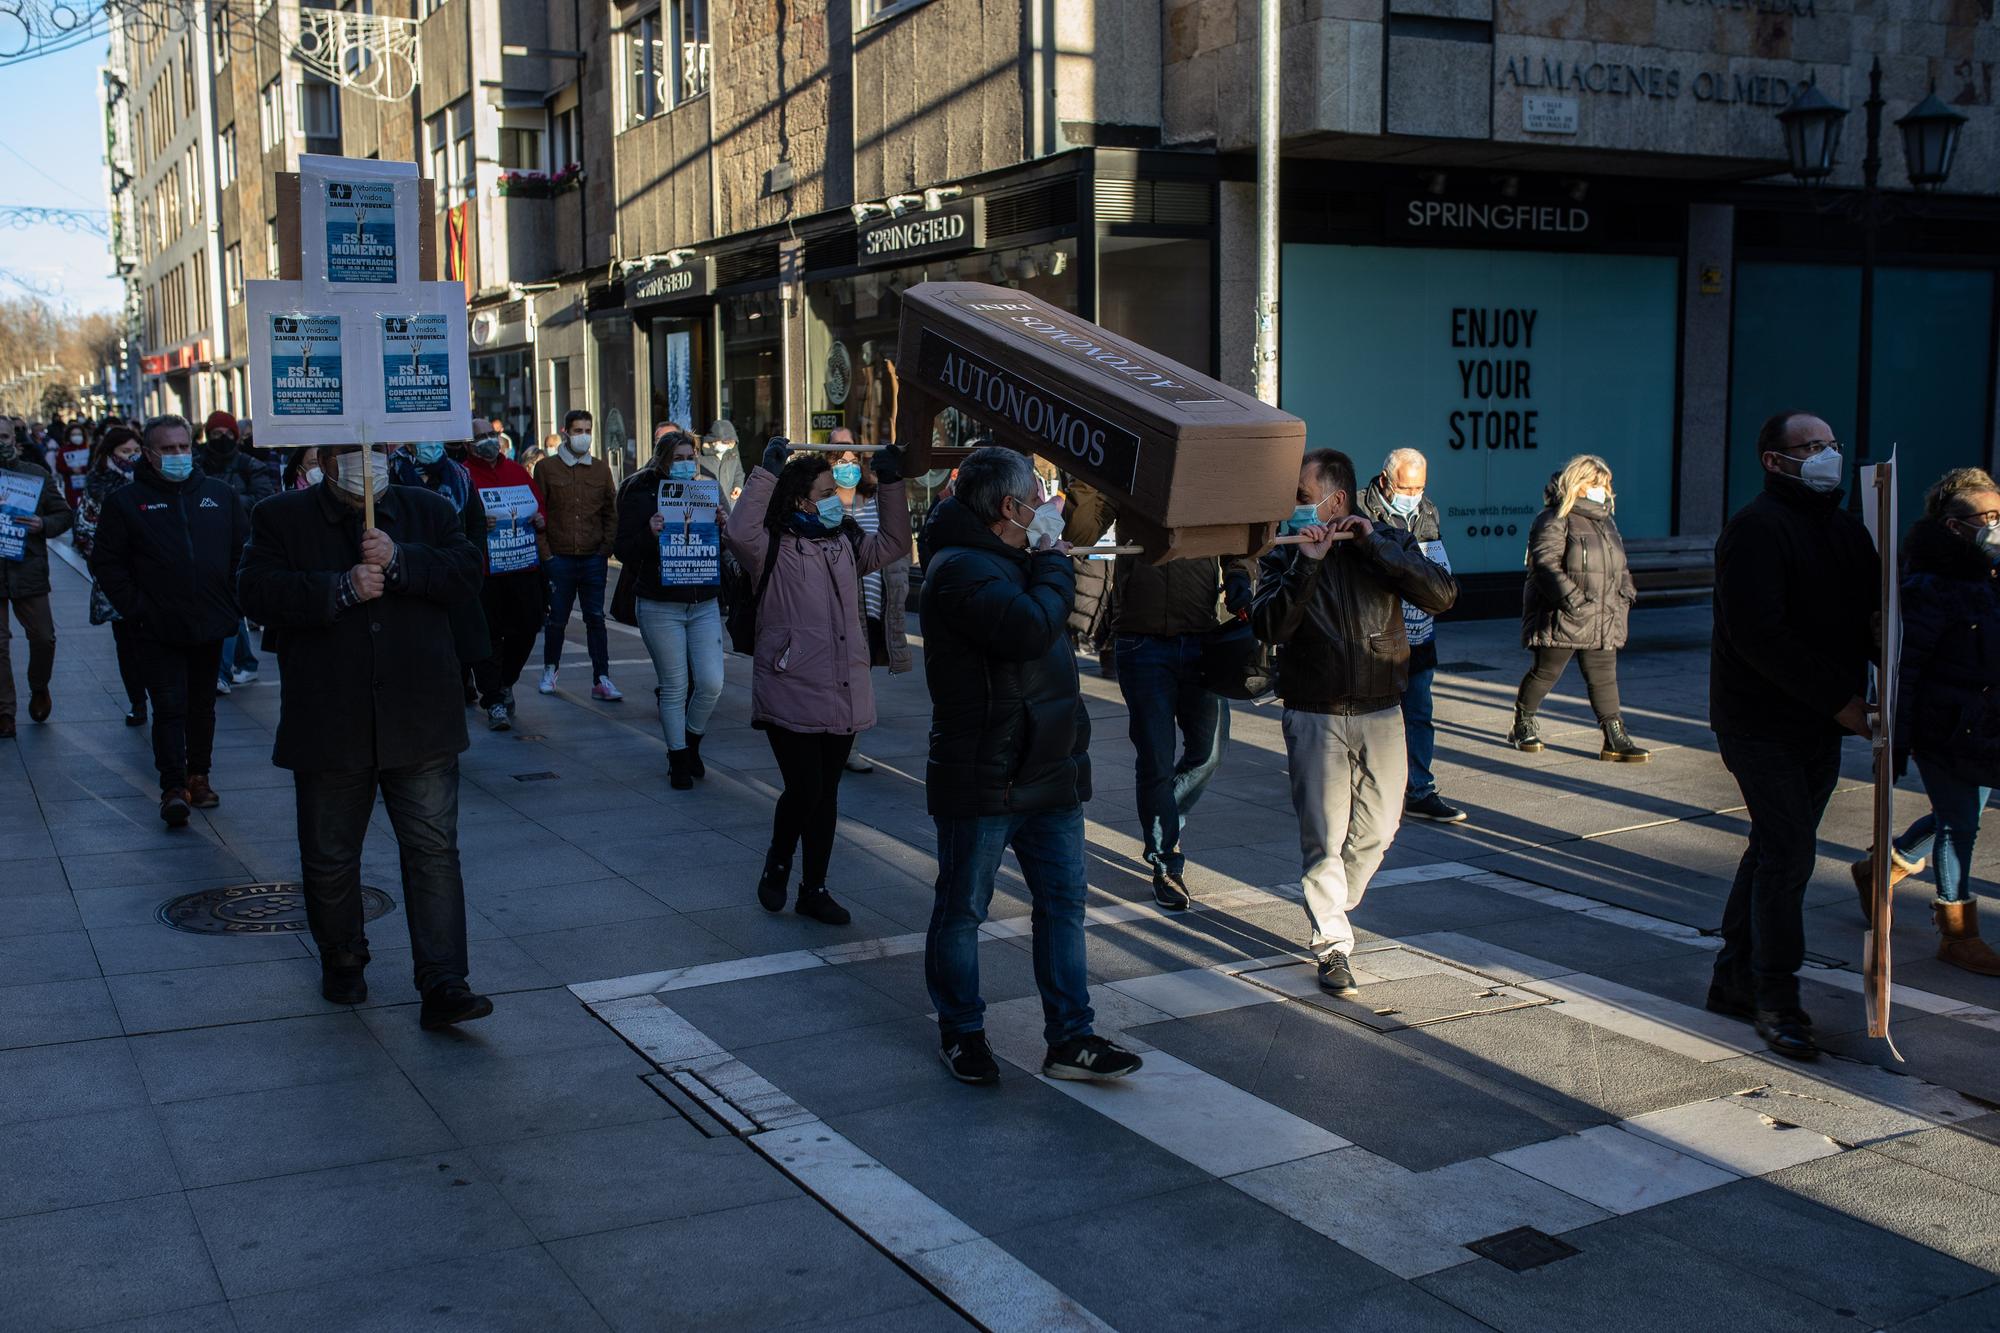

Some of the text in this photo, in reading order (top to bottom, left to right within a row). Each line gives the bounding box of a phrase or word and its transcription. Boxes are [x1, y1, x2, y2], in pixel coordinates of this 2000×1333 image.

[1500, 55, 1680, 99] ALMACENES
[1408, 201, 1589, 232] SPRINGFIELD
[342, 233, 378, 244] ES EL
[866, 213, 965, 255] SPRINGFIELD
[332, 244, 393, 256] MOMENTO
[332, 257, 394, 266] CONCENTRACIÓN
[636, 271, 692, 299] SPRINGFIELD
[1451, 308, 1538, 348] ENJOY
[288, 367, 324, 377] ES EL
[399, 365, 432, 375] ES EL
[276, 377, 340, 388] MOMENTO
[388, 375, 447, 386] MOMENTO
[1458, 360, 1531, 399] YOUR
[276, 390, 340, 398] CONCENTRACIÓN
[389, 387, 448, 396] CONCENTRACIÓN
[940, 352, 1106, 467] AUTÓNOMOS
[813, 415, 837, 428] CYBER
[1449, 410, 1538, 450] STORE
[1448, 506, 1476, 517] Share
[1479, 505, 1499, 516] with
[500, 527, 525, 538] ES EL
[490, 534, 535, 550] MOMENTO
[670, 534, 702, 545] ES EL
[662, 546, 717, 557] MOMENTO
[663, 559, 717, 567] CONCENTRACIÓN
[1075, 1050, 1098, 1066] N
